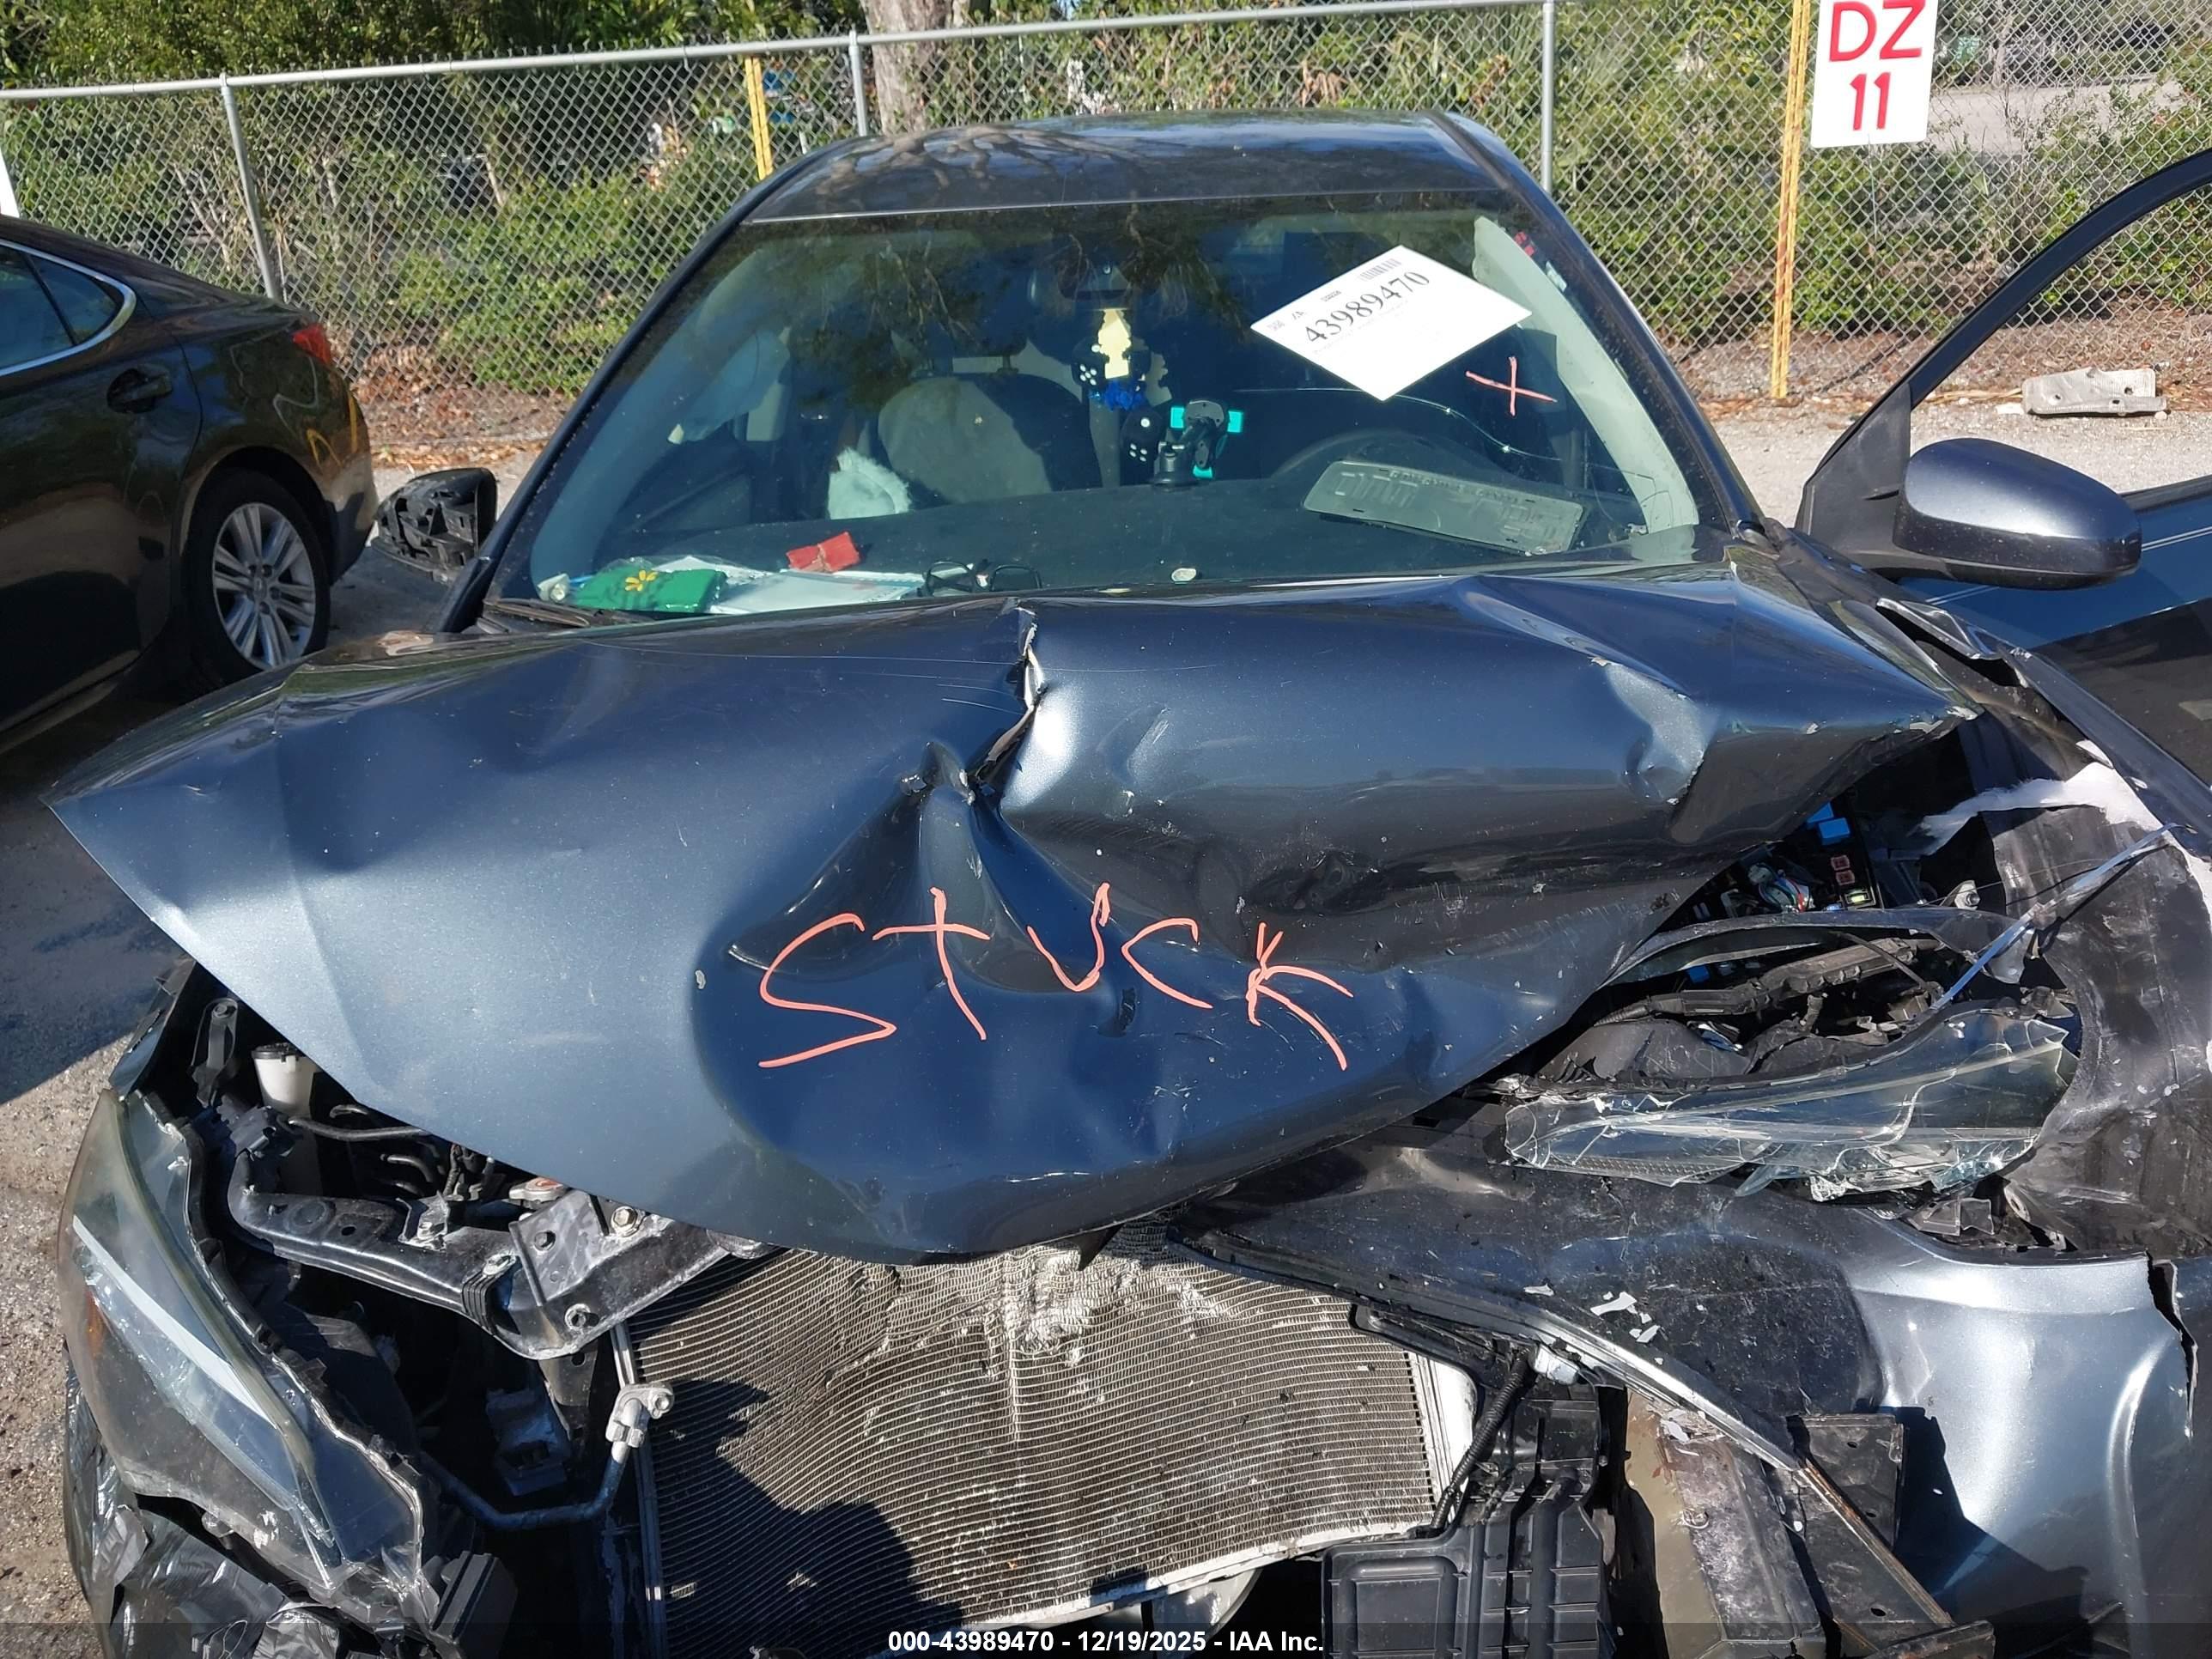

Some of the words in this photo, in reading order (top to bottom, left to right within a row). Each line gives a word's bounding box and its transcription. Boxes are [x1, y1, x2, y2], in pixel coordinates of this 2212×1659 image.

[1829, 0, 1926, 62] DZ
[1850, 72, 1891, 131] 11
[1305, 271, 1430, 342] 43989470
[759, 882, 1354, 1071] STUCK
